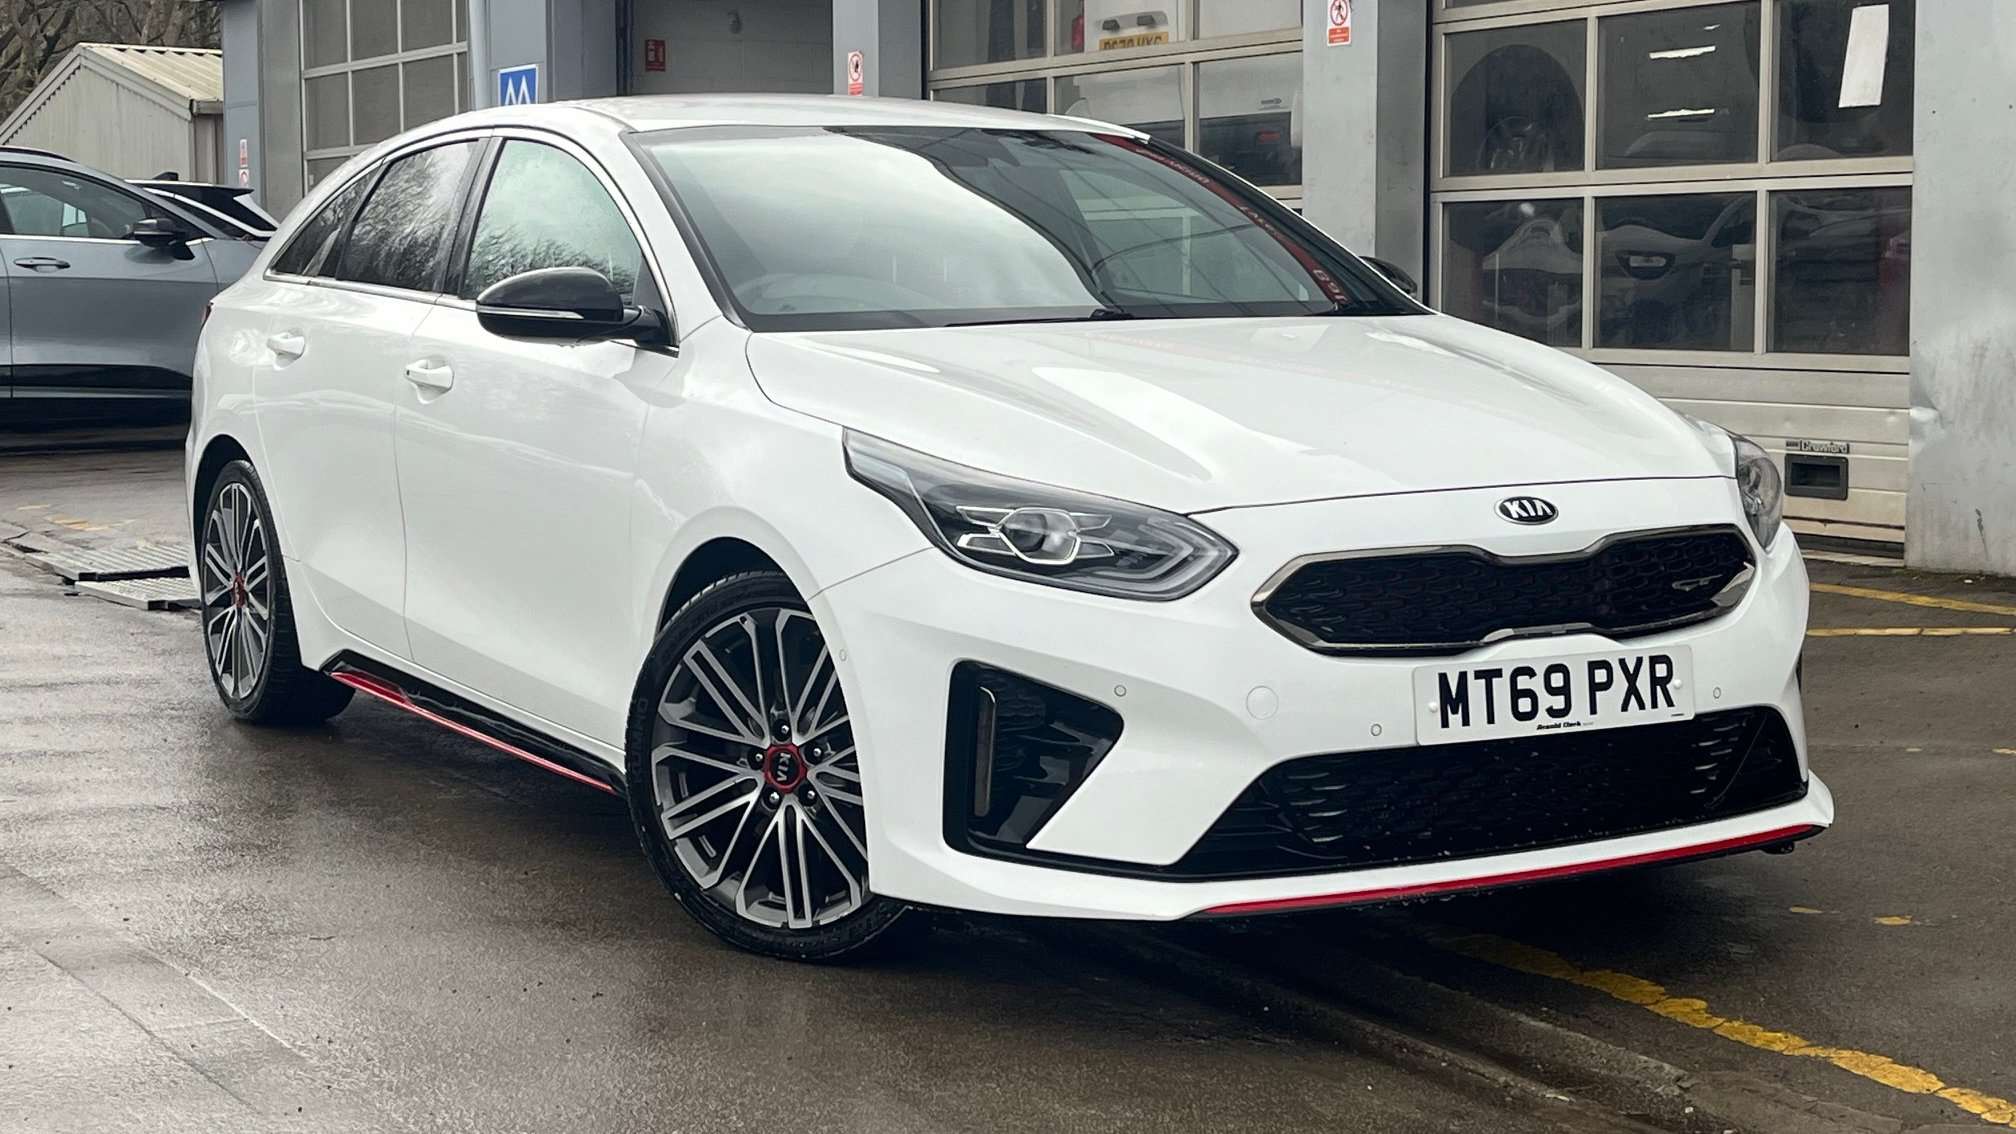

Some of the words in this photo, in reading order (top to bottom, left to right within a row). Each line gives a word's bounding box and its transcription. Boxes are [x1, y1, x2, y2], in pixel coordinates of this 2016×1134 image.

[1503, 499, 1554, 519] KIA
[1438, 663, 1572, 729] MT69
[1587, 654, 1675, 716] PXR
[776, 752, 792, 782] KIA
